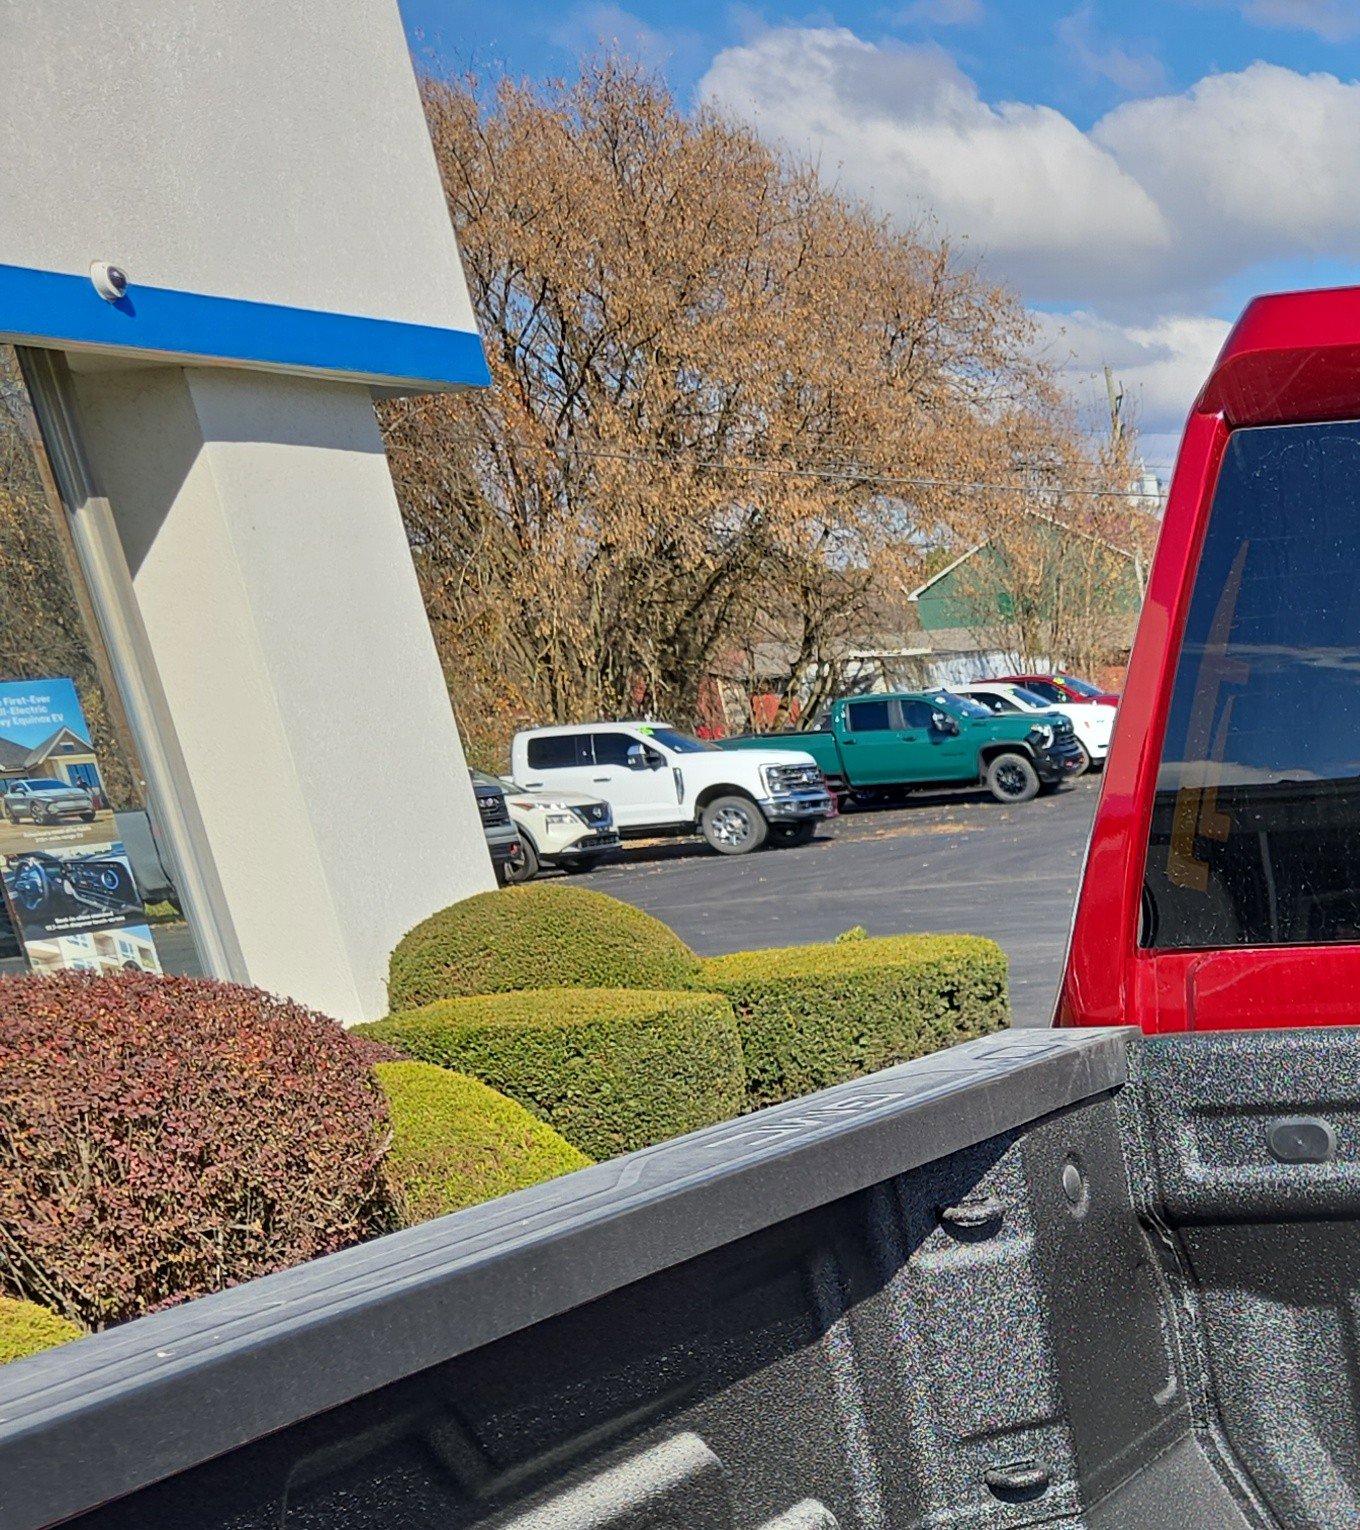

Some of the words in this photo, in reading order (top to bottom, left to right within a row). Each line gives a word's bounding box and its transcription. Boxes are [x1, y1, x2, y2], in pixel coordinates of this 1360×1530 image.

[0, 705, 48, 716] ll-Electric
[12, 716, 51, 727] Equinox
[51, 713, 64, 723] EV
